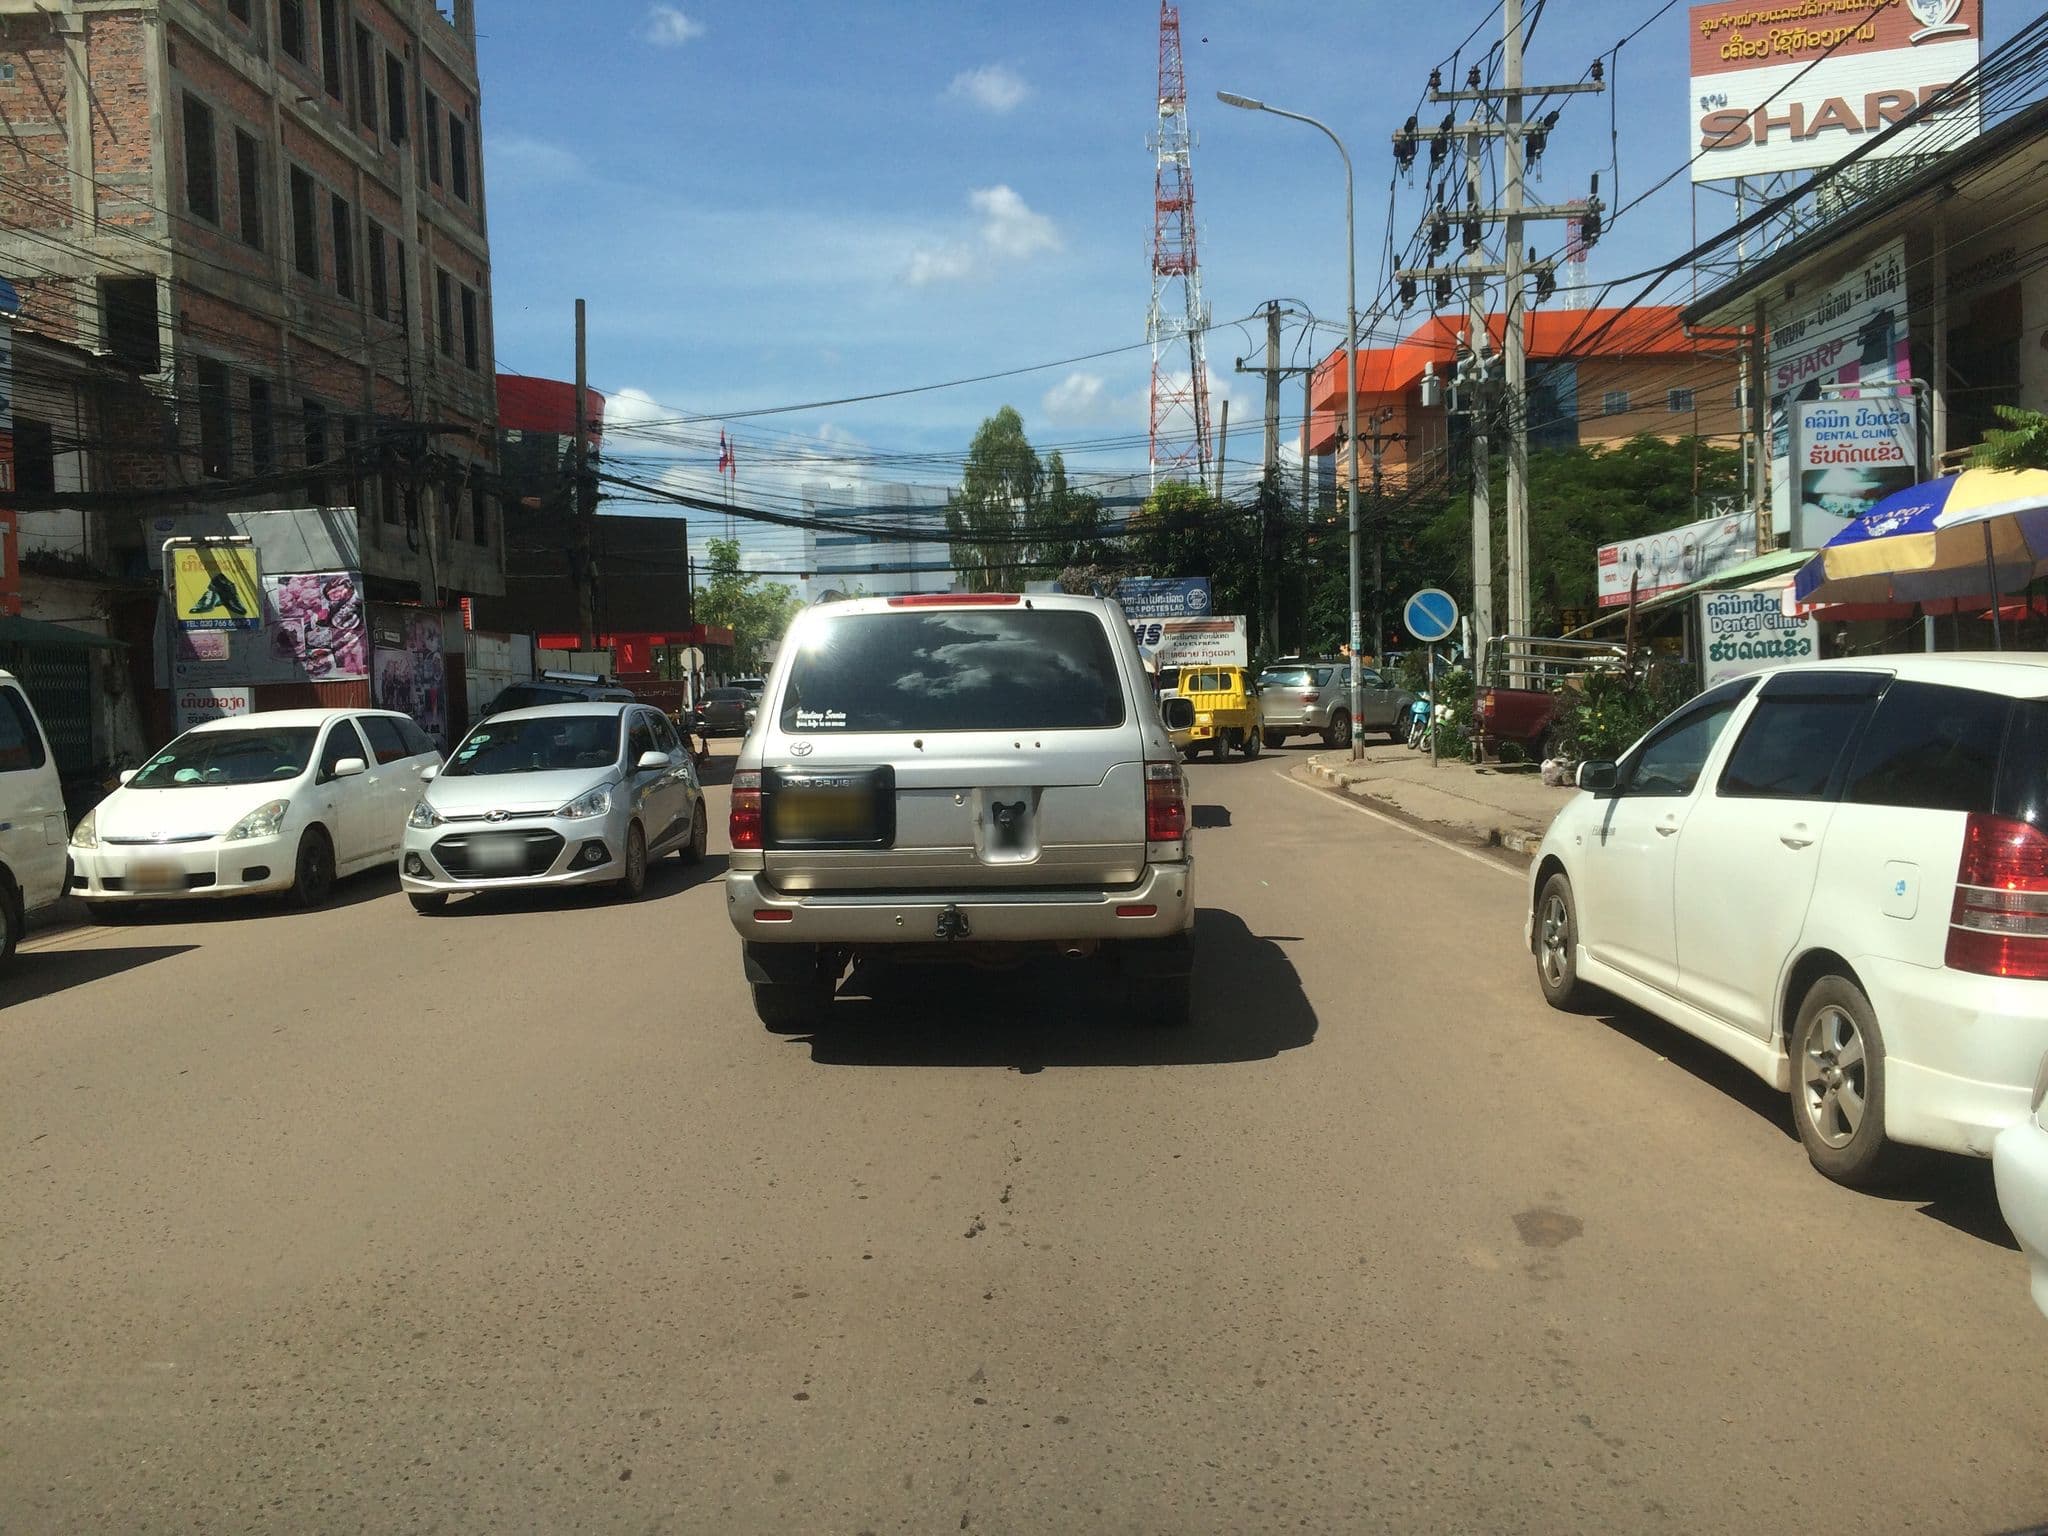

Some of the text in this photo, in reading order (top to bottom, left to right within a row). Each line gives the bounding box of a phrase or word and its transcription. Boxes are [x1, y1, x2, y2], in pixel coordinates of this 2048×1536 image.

[1700, 83, 1970, 150] SHARP
[1777, 337, 1845, 389] SHARP
[1816, 428, 1898, 441] DENTAL CLINIC
[1141, 605, 1169, 613] POSTES
[1170, 604, 1185, 612] LAO
[1711, 613, 1808, 633] Dental Clinic
